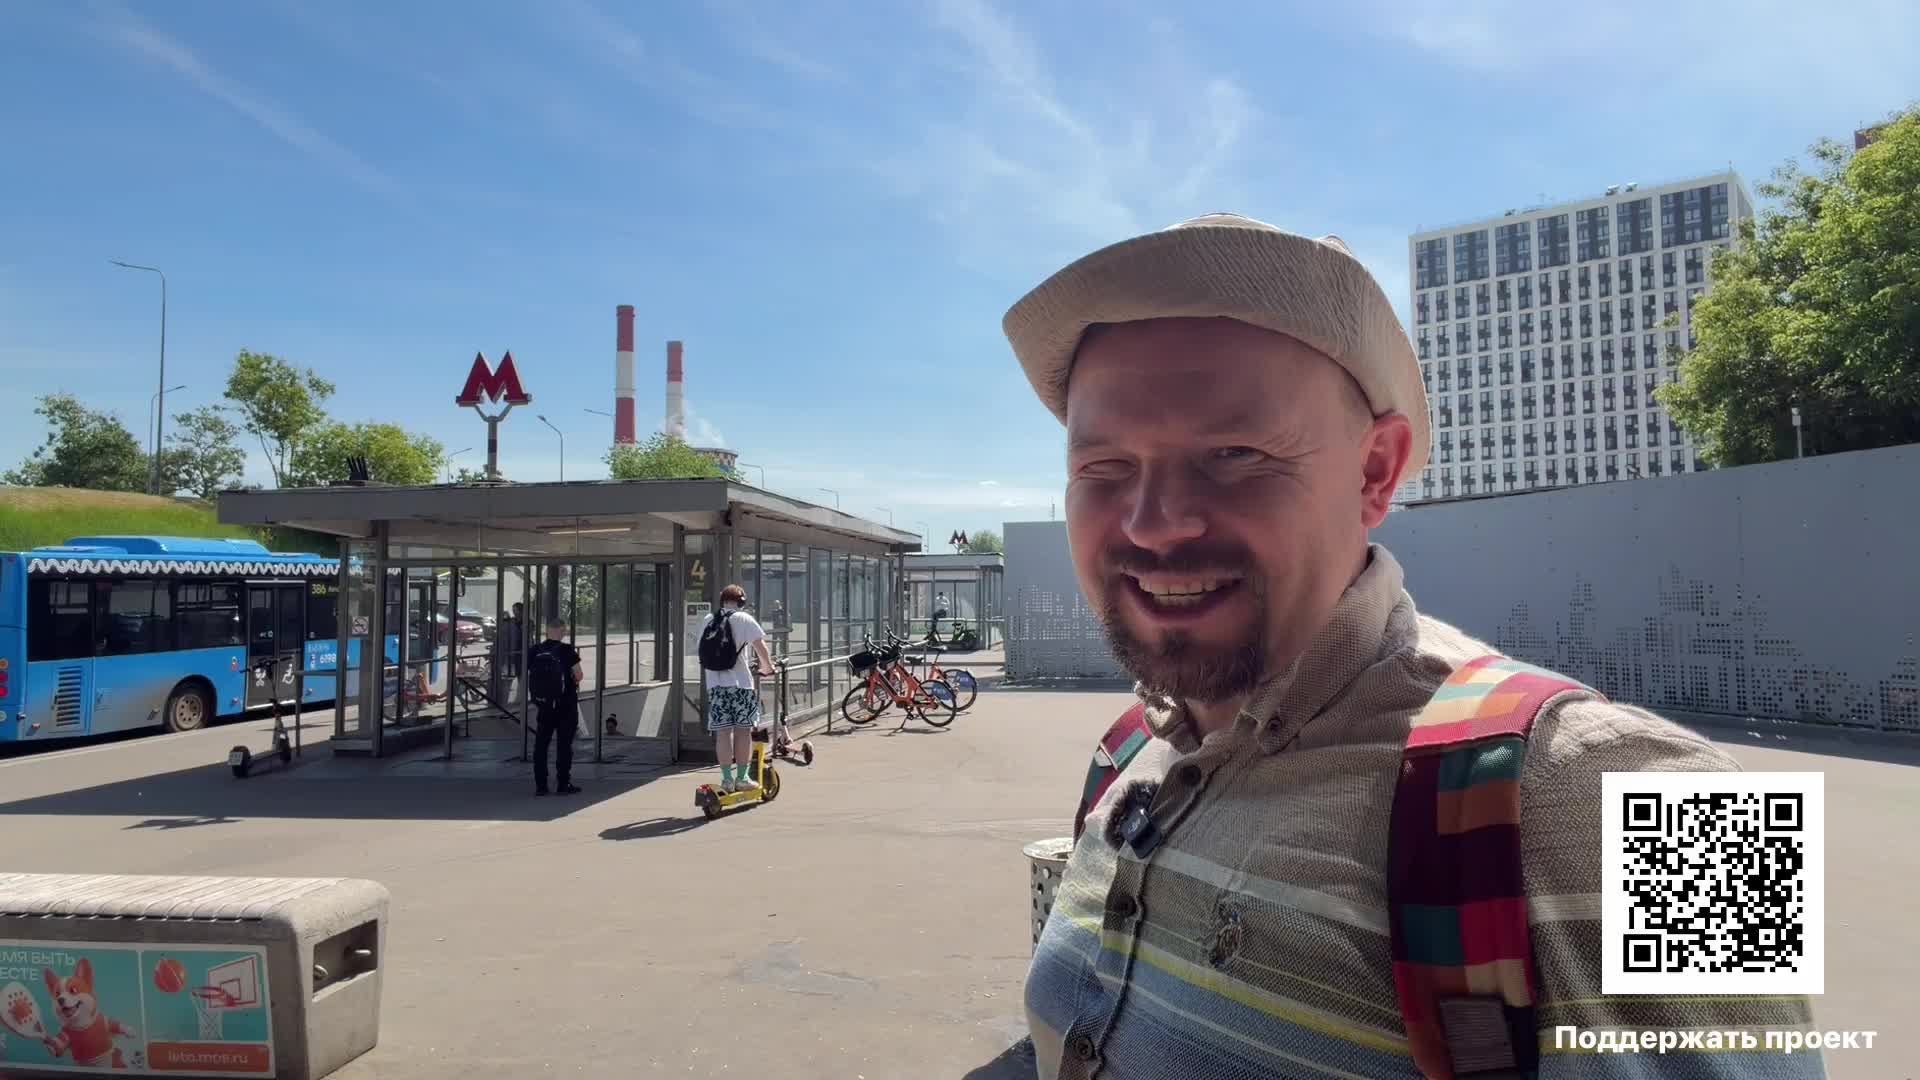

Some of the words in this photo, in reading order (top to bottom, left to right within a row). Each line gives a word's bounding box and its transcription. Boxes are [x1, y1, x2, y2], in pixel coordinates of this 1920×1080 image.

[691, 559, 706, 581] 4
[312, 584, 326, 594] 386
[0, 951, 28, 964] МЯ
[31, 951, 76, 967] БЫТЬ
